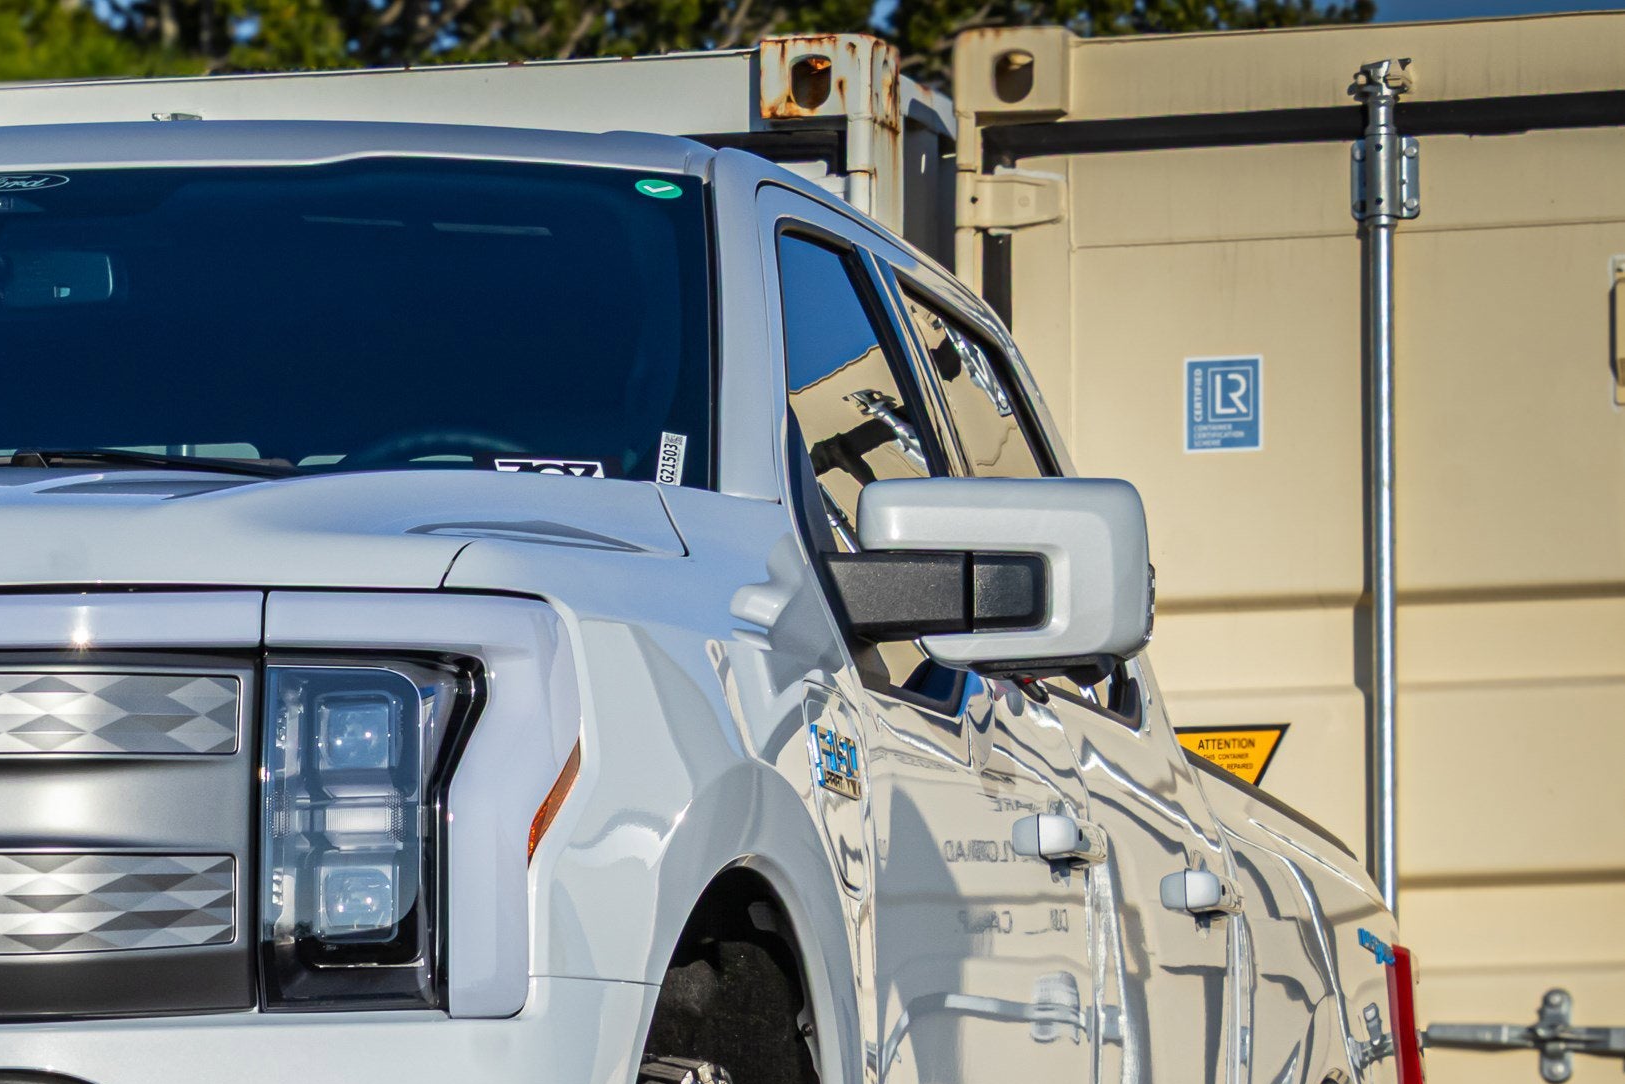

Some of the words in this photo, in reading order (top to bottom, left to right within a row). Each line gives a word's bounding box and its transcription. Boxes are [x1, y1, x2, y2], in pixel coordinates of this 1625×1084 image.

[1215, 373, 1248, 414] LR
[659, 443, 679, 484] G21503
[1198, 738, 1255, 750] ATTENTION
